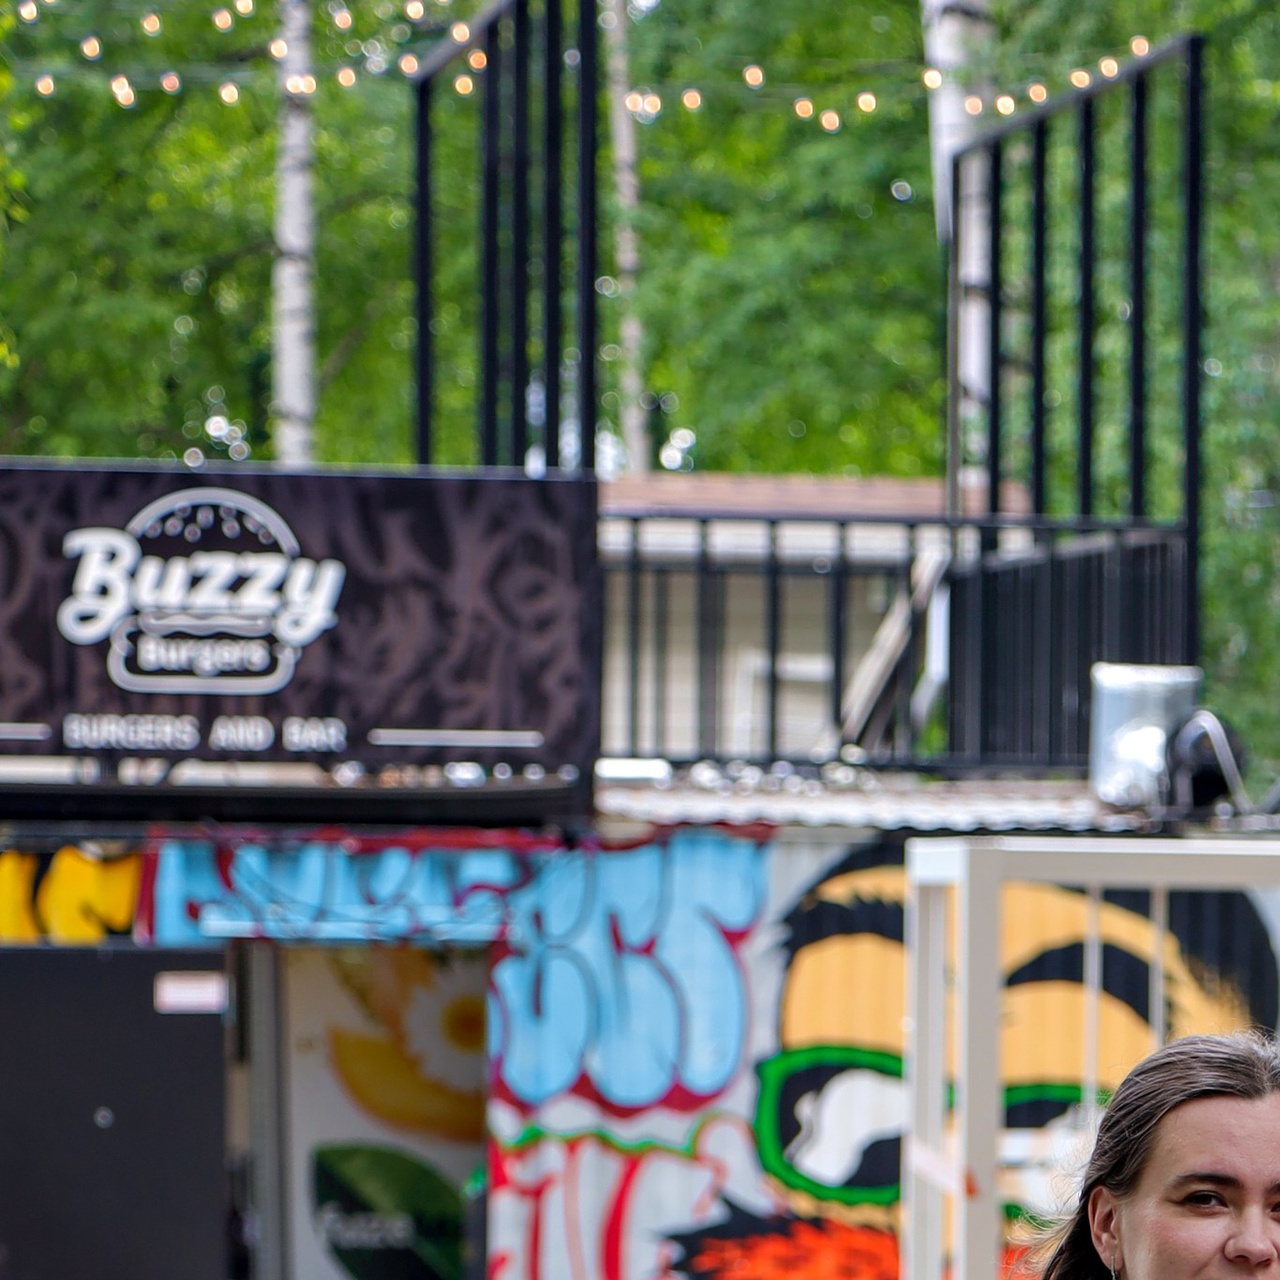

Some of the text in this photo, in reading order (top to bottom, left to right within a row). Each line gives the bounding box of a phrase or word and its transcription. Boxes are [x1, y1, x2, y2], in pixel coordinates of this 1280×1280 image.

[58, 527, 346, 645] Buzzy
[63, 713, 347, 752] BURGERS AND BAR
